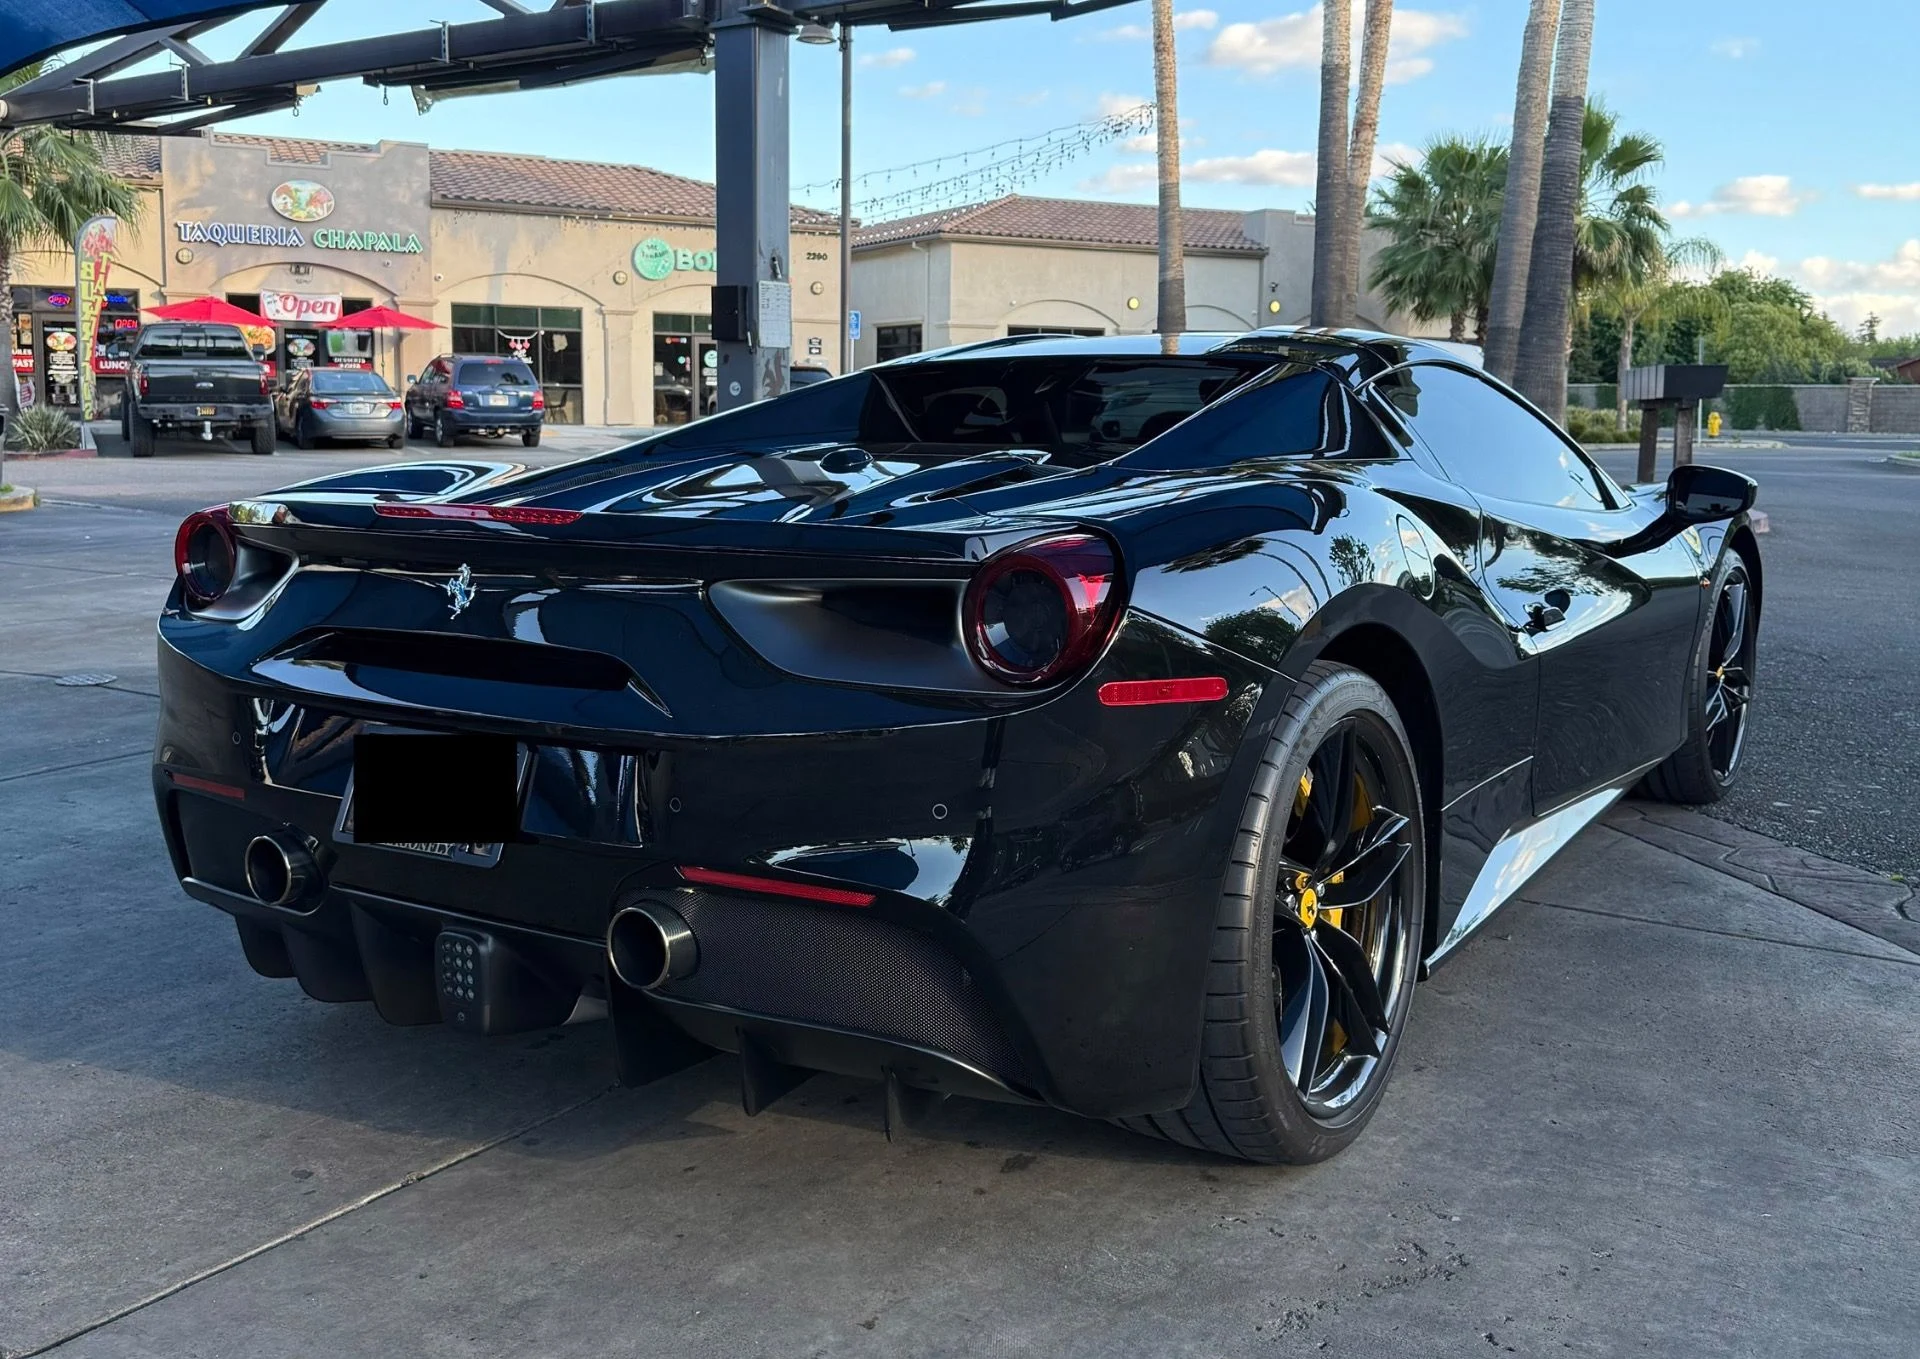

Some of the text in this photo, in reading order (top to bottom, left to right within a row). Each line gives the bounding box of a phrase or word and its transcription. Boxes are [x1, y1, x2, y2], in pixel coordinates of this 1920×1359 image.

[177, 221, 423, 254] TAQUERIA CHAPALA
[279, 294, 337, 320] Open
[115, 319, 138, 329] OPEN
